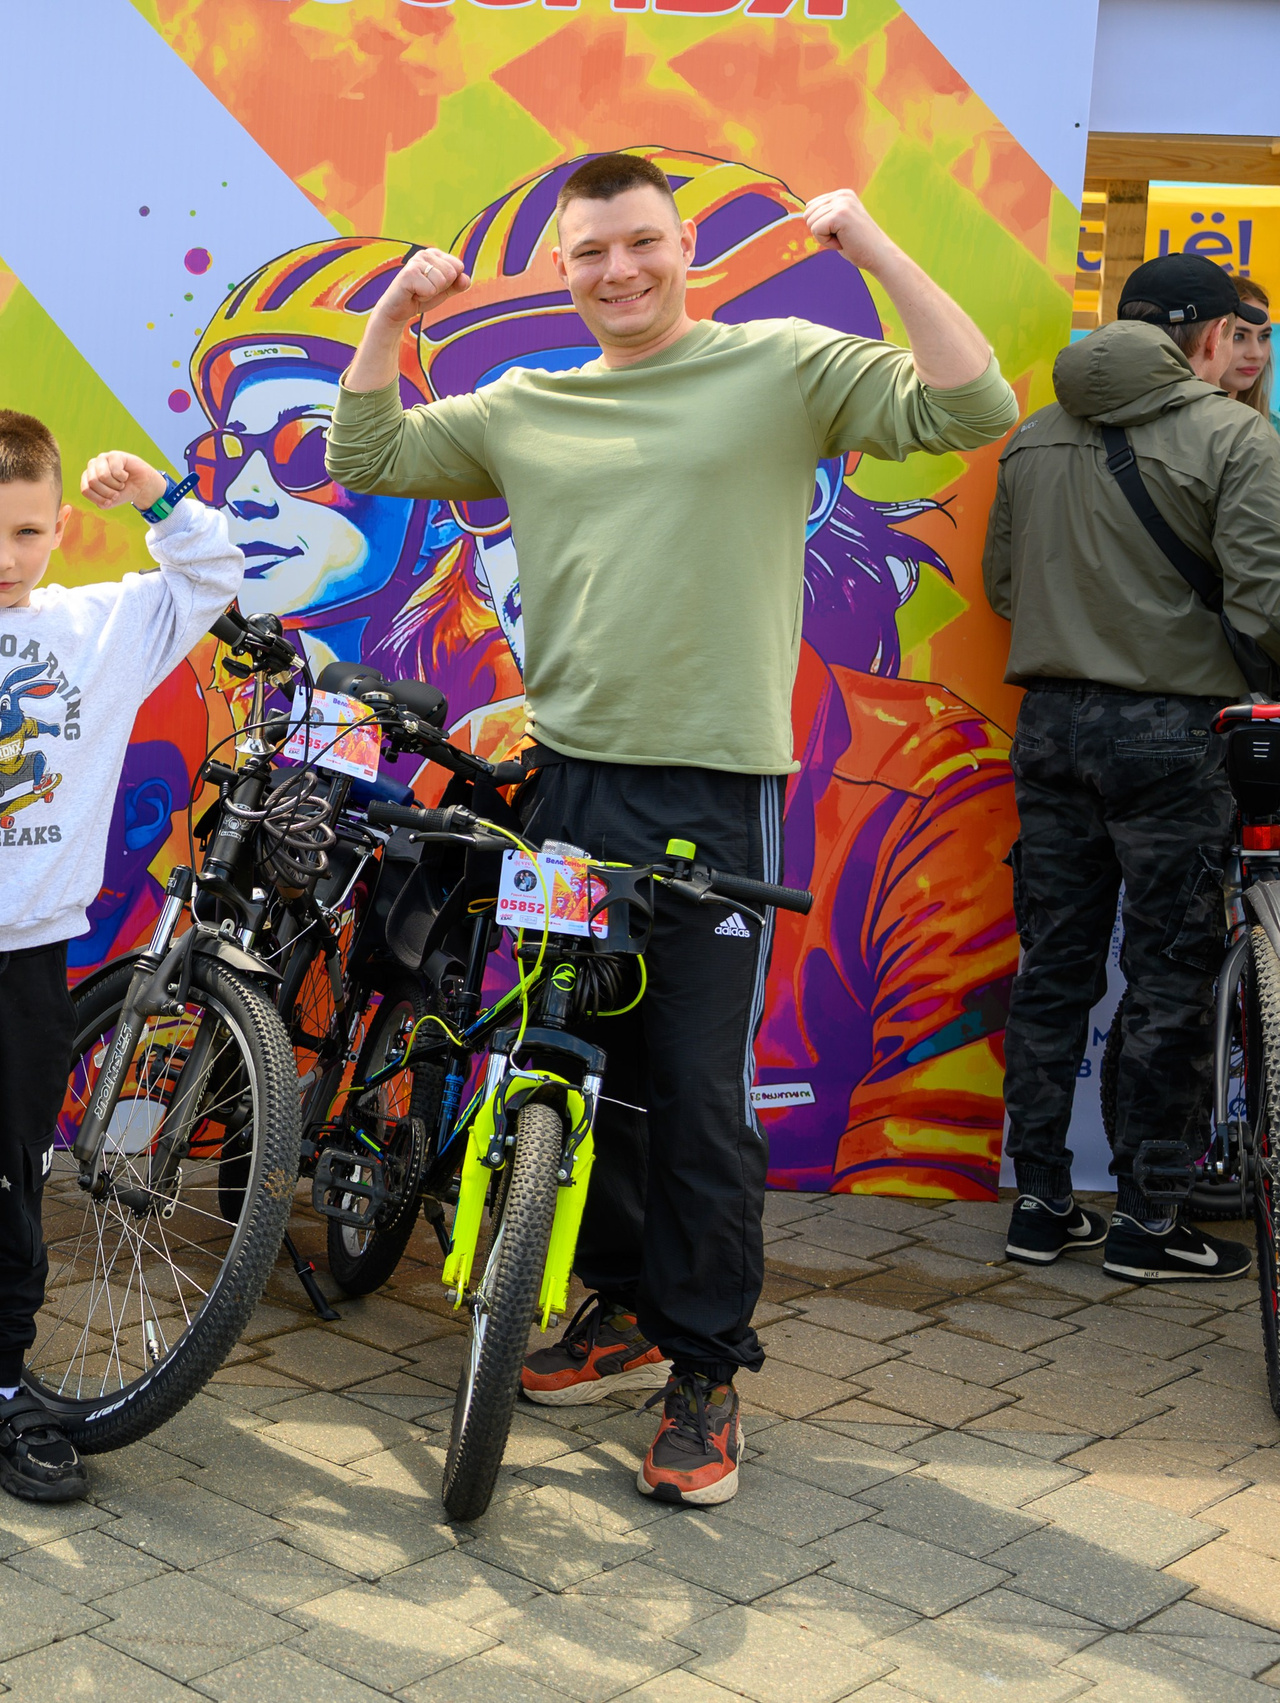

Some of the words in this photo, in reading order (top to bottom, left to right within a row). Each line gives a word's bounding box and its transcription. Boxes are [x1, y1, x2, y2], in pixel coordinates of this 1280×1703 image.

[500, 898, 545, 915] 05852
[714, 925, 751, 938] adidas
[1023, 1200, 1039, 1208] NIKE
